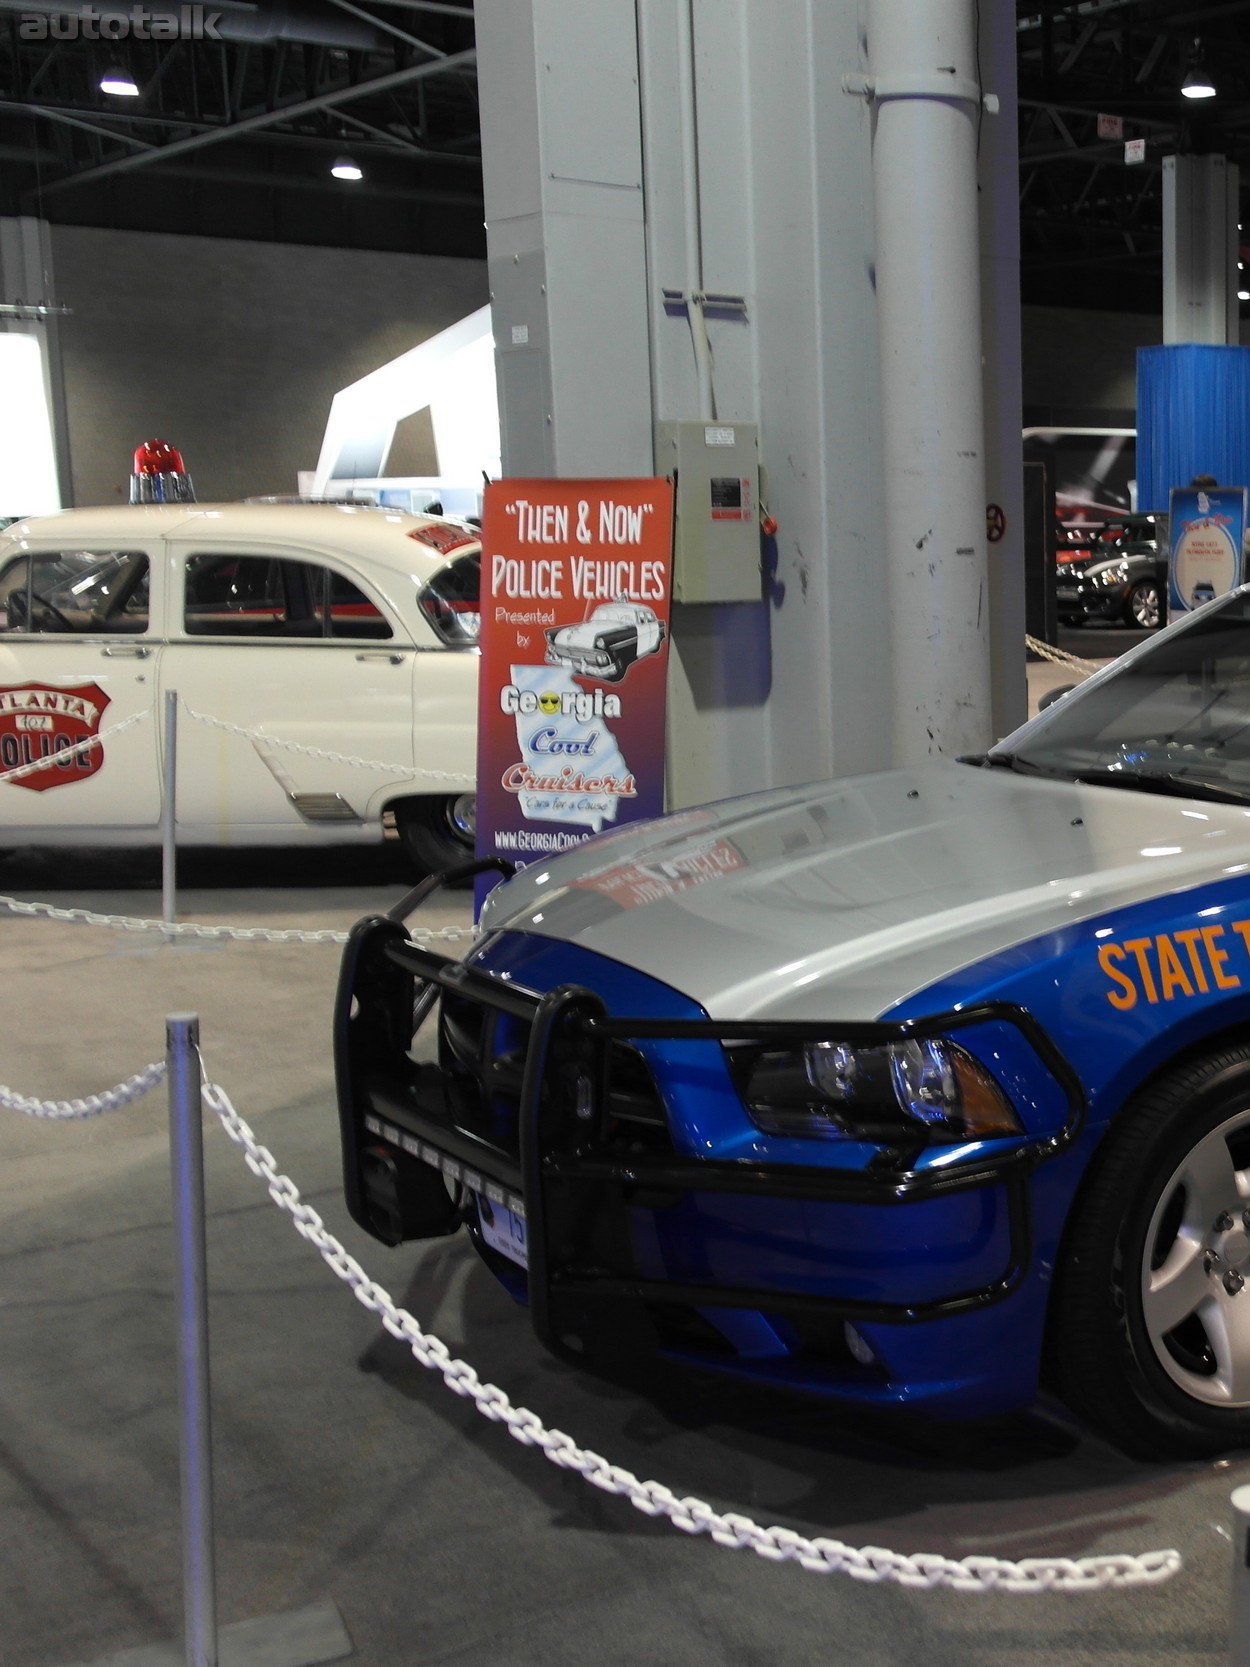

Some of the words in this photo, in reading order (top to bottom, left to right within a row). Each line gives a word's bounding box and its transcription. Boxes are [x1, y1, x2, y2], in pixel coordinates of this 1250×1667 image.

[576, 500, 592, 544] &
[492, 555, 563, 599] POLICE
[570, 556, 666, 600] VEHICLES
[495, 607, 555, 624] Presented
[517, 631, 531, 648] by
[529, 726, 599, 756] Cool
[501, 763, 638, 797] Cruisers
[1098, 924, 1241, 1011] STATE
